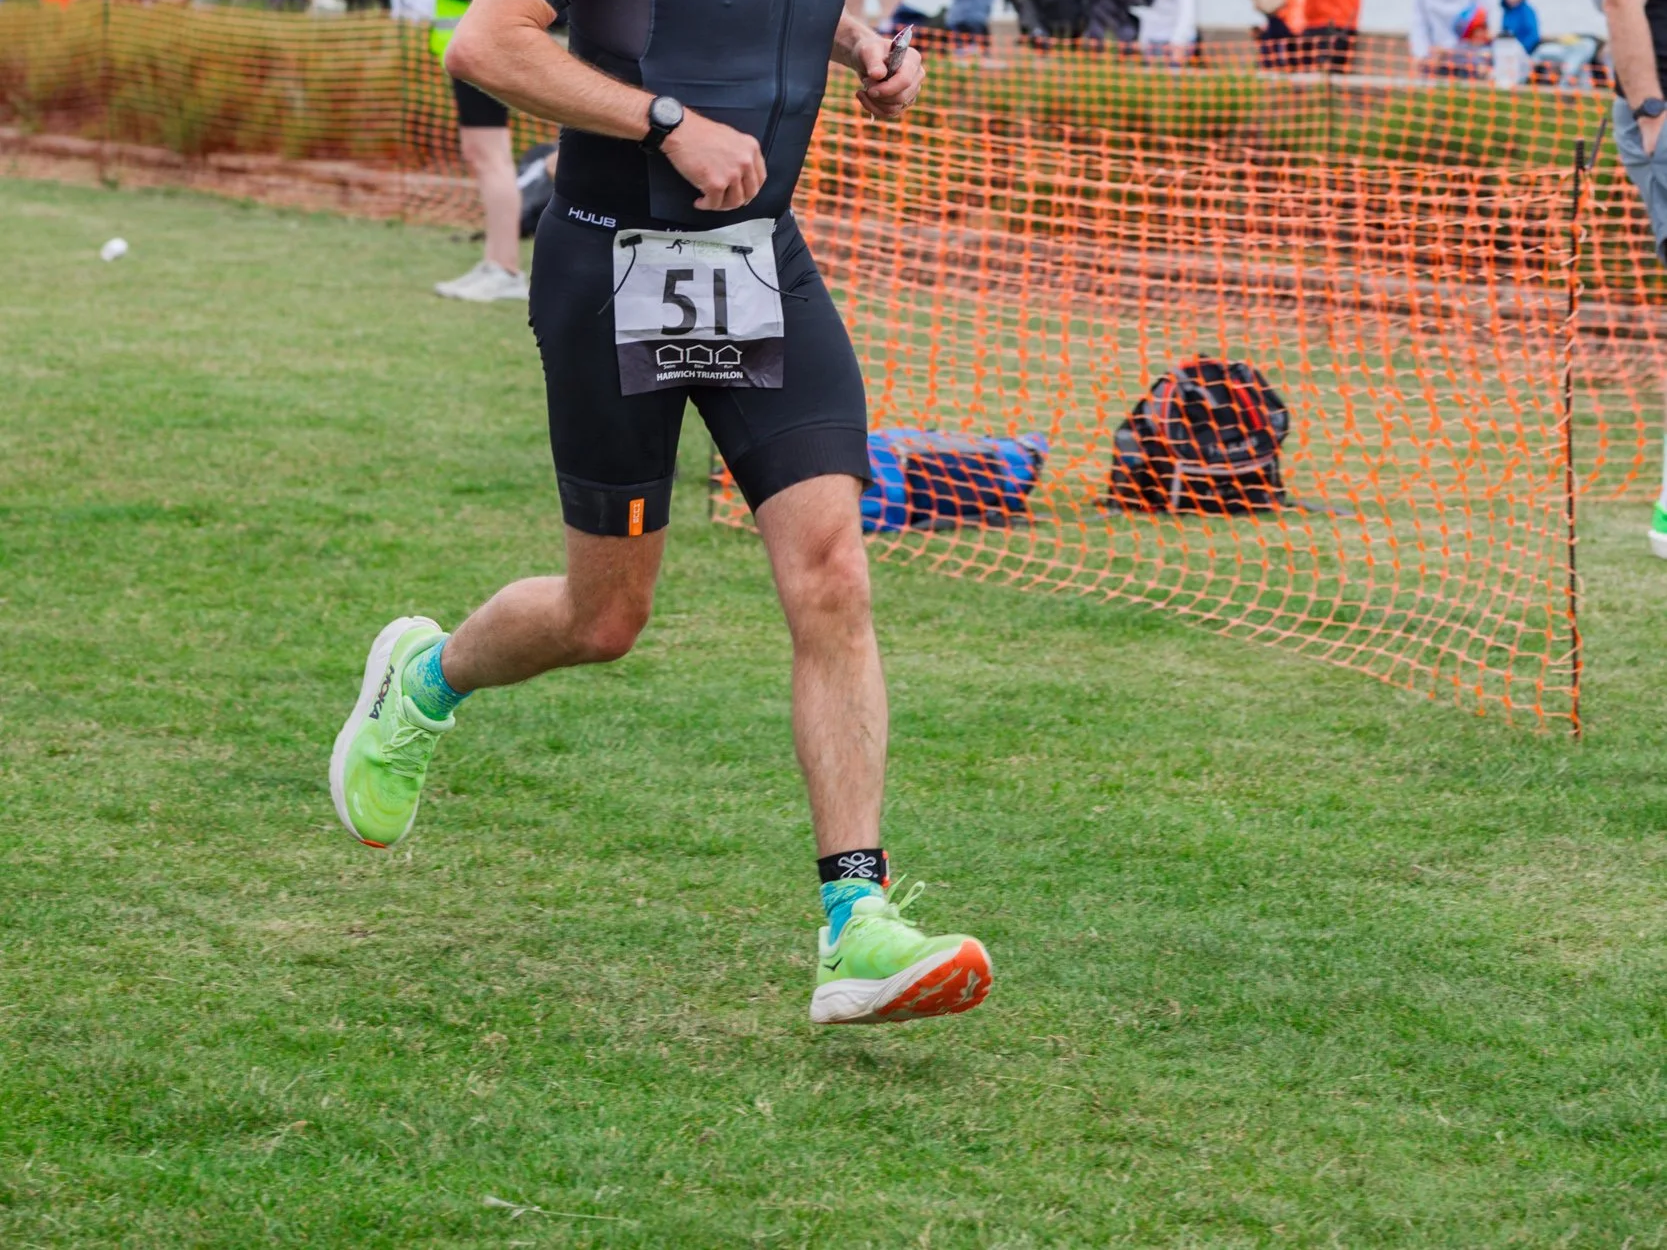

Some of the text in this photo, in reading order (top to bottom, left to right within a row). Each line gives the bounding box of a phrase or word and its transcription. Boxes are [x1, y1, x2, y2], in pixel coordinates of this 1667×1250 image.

[568, 206, 617, 228] HUUB
[660, 268, 729, 335] 51
[657, 370, 743, 381] HARWICH TRIATHLON
[369, 664, 395, 720] HOKA
